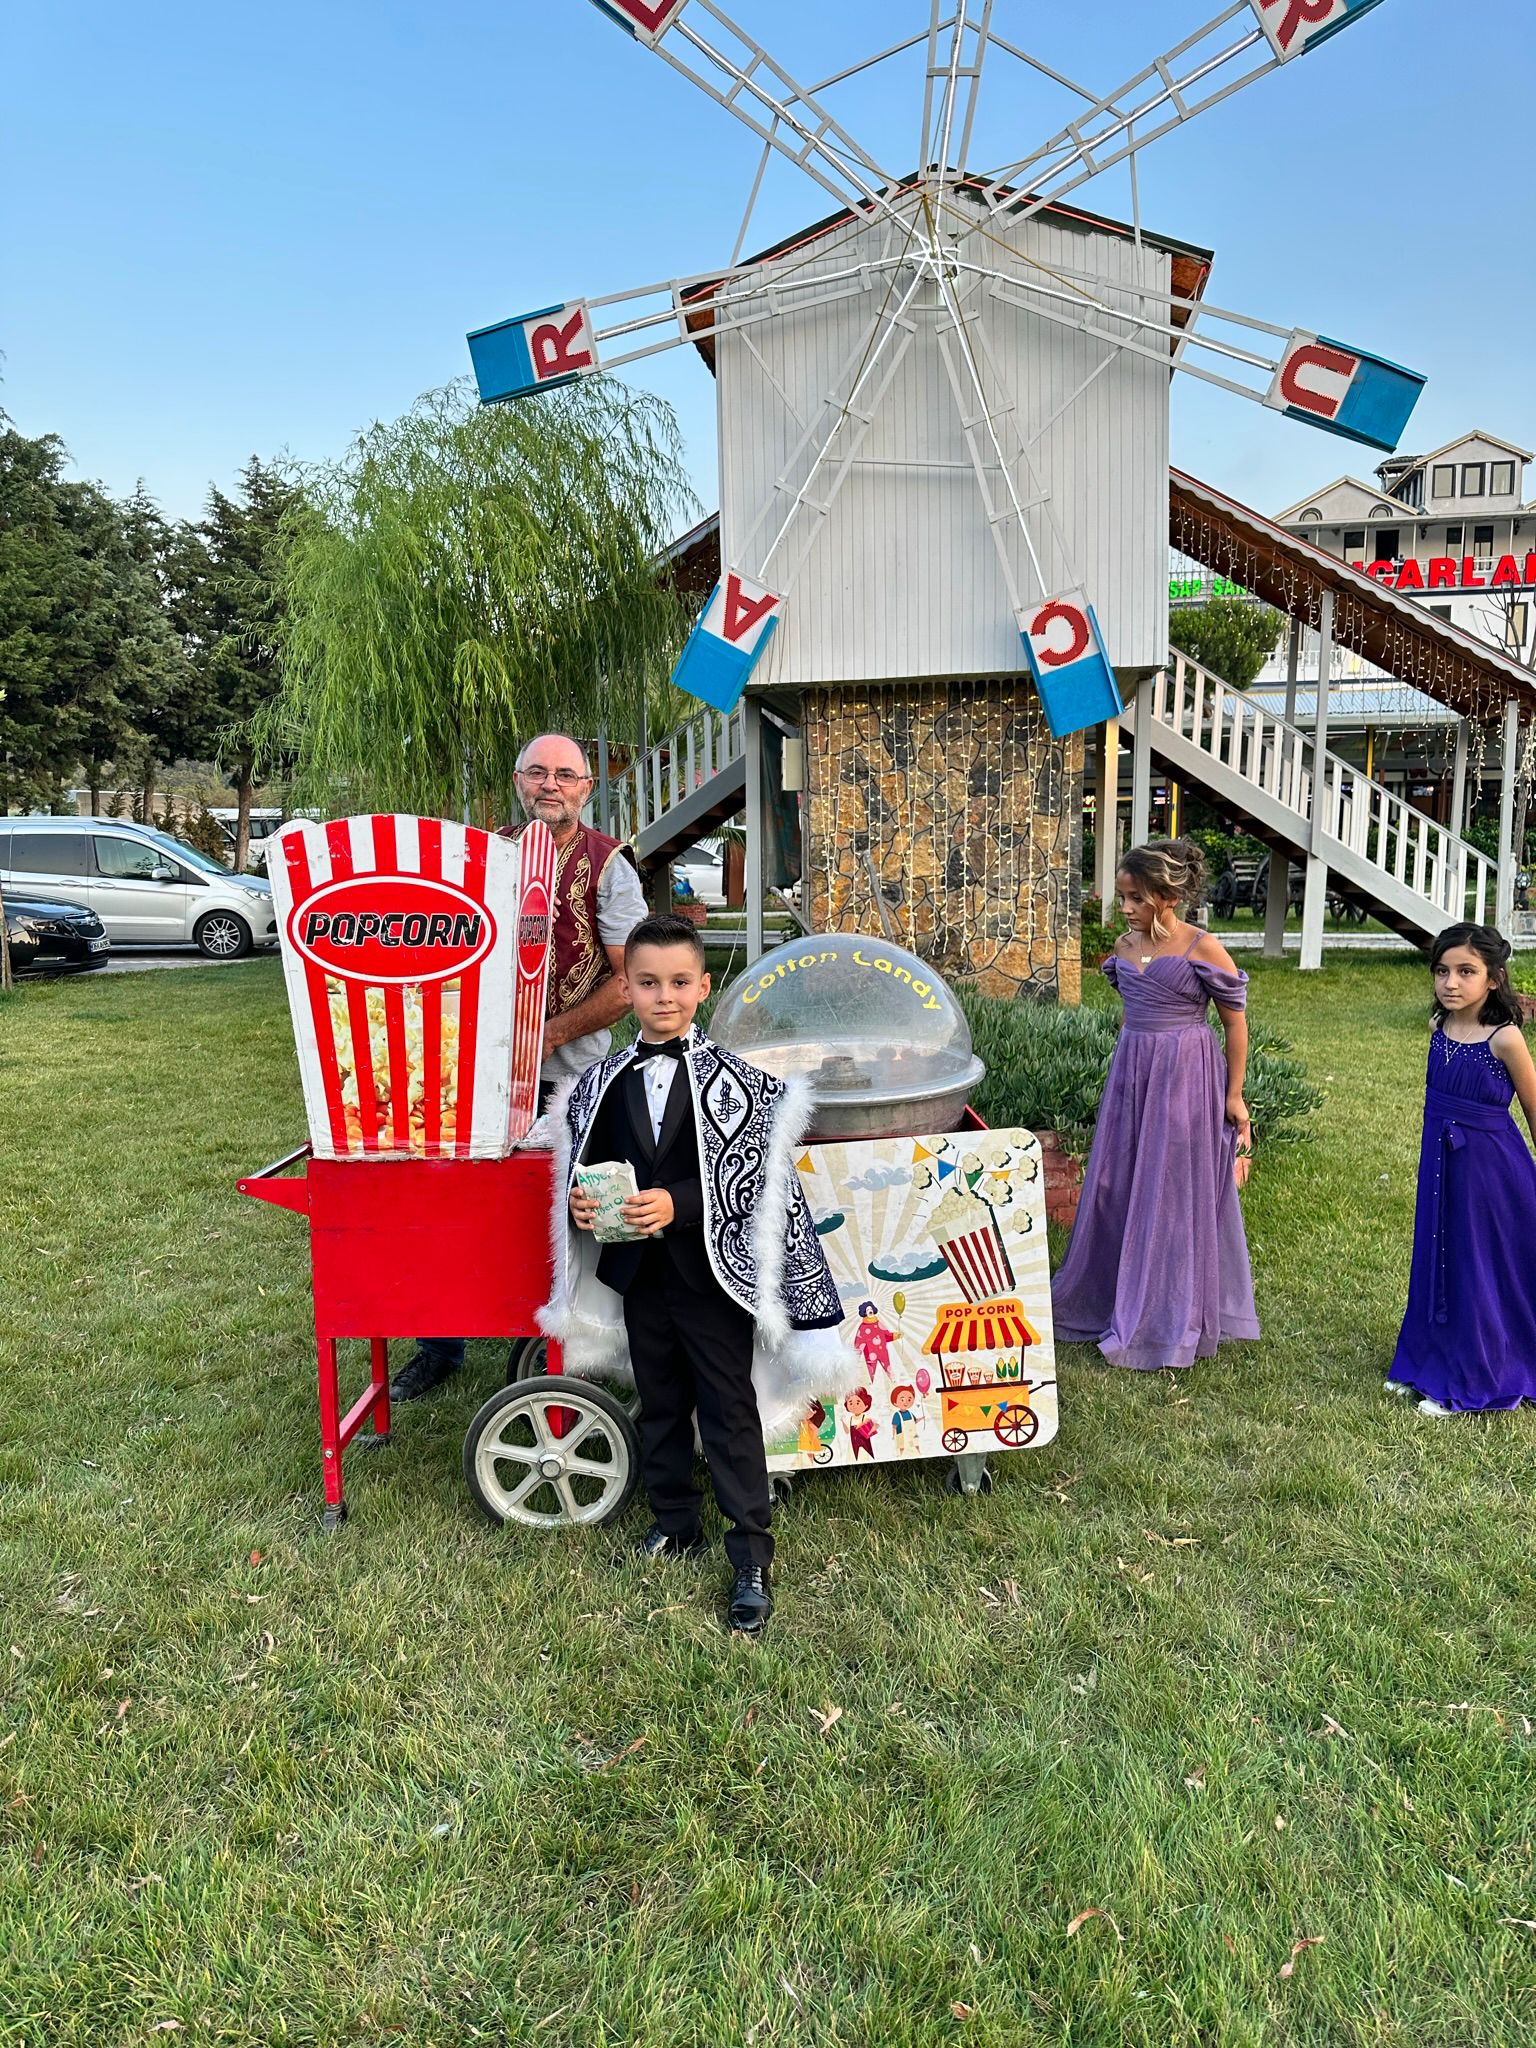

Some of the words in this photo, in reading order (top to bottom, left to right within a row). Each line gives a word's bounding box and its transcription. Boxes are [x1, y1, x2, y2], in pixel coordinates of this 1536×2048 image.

[531, 308, 592, 380] R
[1280, 344, 1358, 418] U
[722, 572, 780, 642] A
[305, 912, 482, 948] POPCORN
[945, 1308, 972, 1319] POP
[977, 1304, 1015, 1316] CORN
